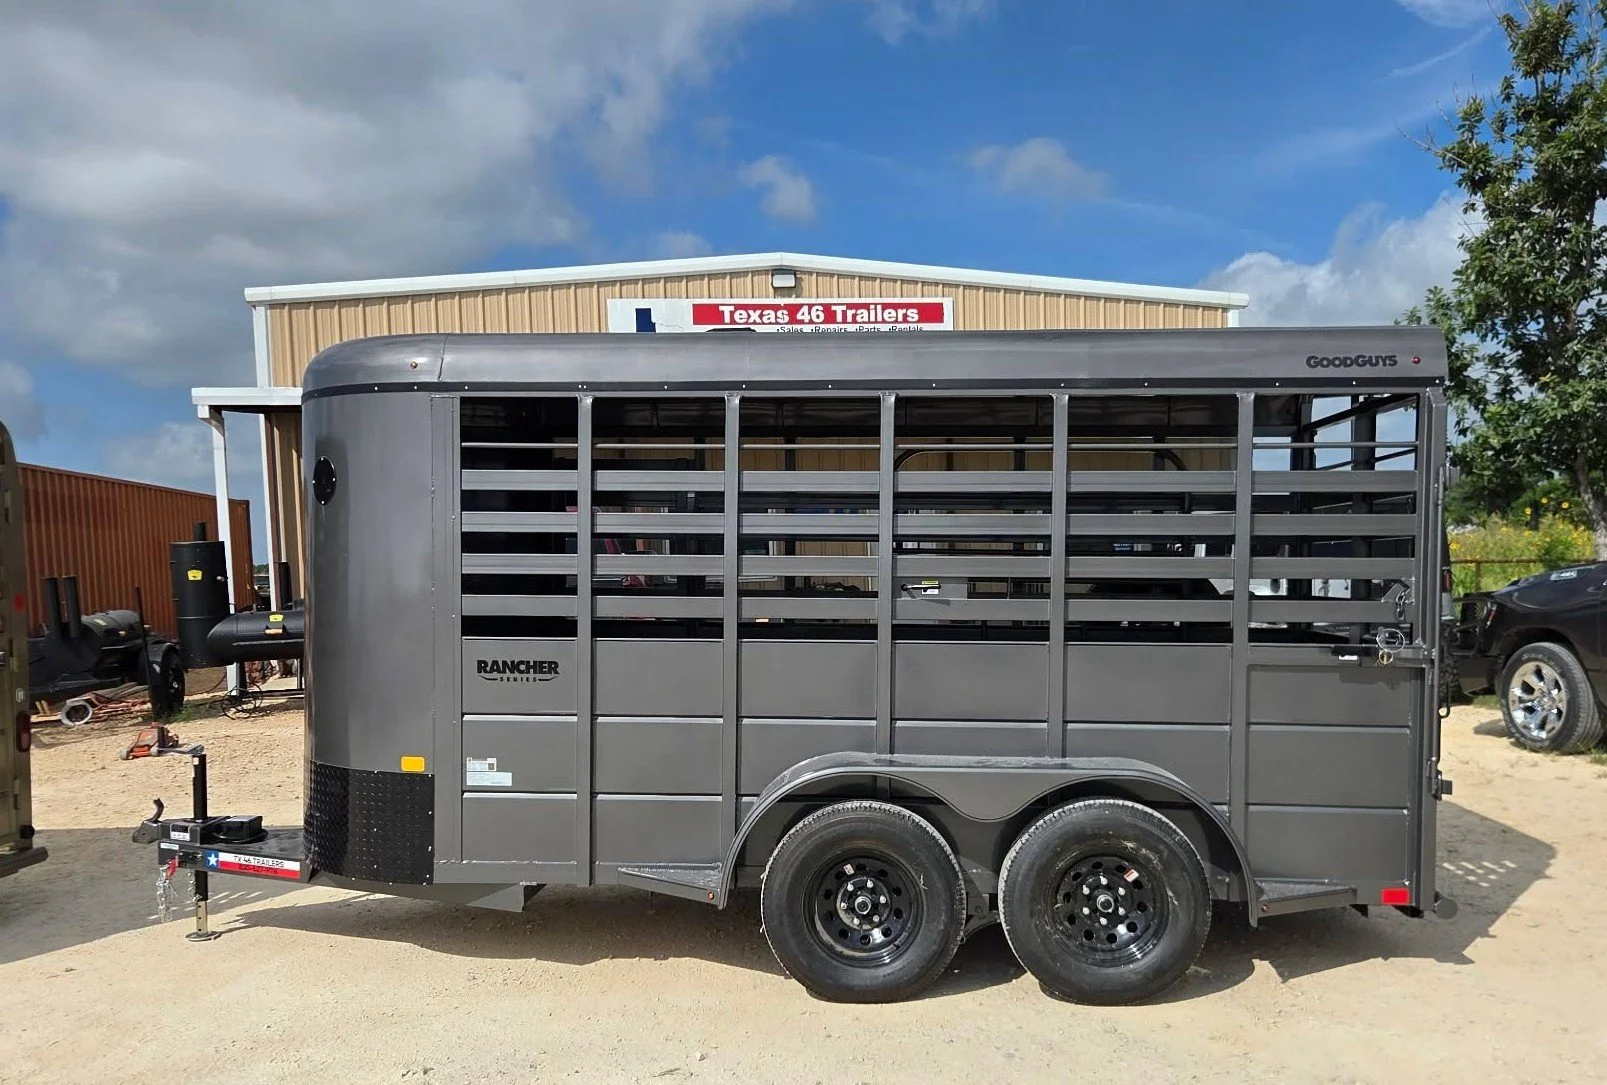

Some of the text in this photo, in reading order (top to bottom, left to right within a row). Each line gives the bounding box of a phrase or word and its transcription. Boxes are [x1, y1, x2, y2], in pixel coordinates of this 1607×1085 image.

[718, 304, 919, 323] Texas 46 Trailers
[477, 660, 560, 674] RANCHER
[252, 857, 284, 867] TRAILERS
